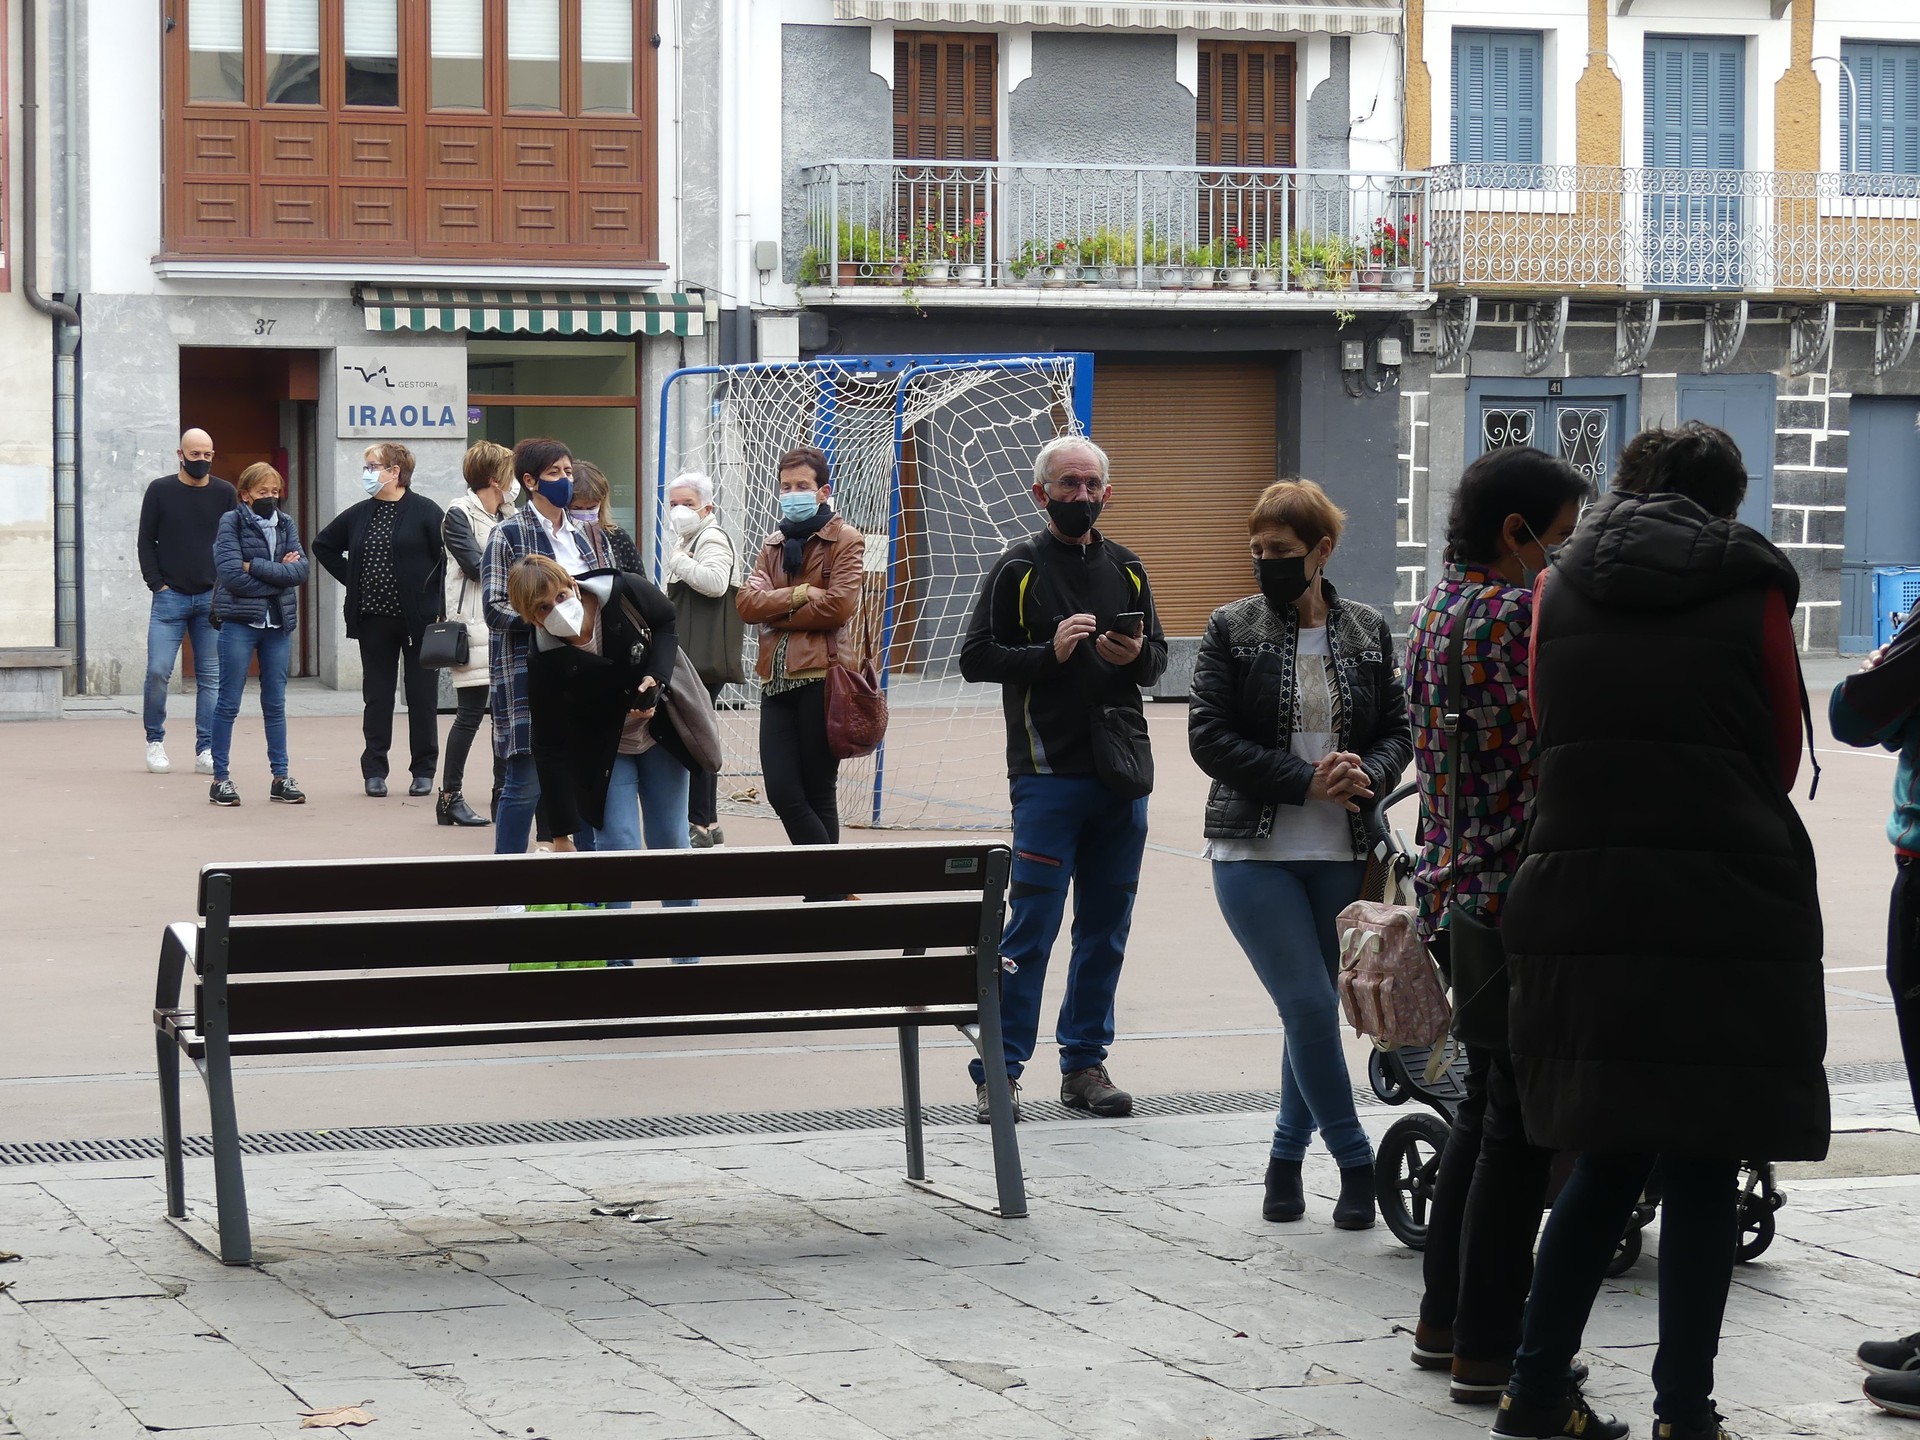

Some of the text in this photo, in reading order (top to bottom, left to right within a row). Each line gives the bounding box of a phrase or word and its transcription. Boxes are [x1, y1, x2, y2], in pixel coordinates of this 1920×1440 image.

[254, 318, 277, 335] 37
[1550, 382, 1561, 393] 41
[349, 405, 456, 427] IRAOLA
[1563, 1409, 1588, 1436] N
